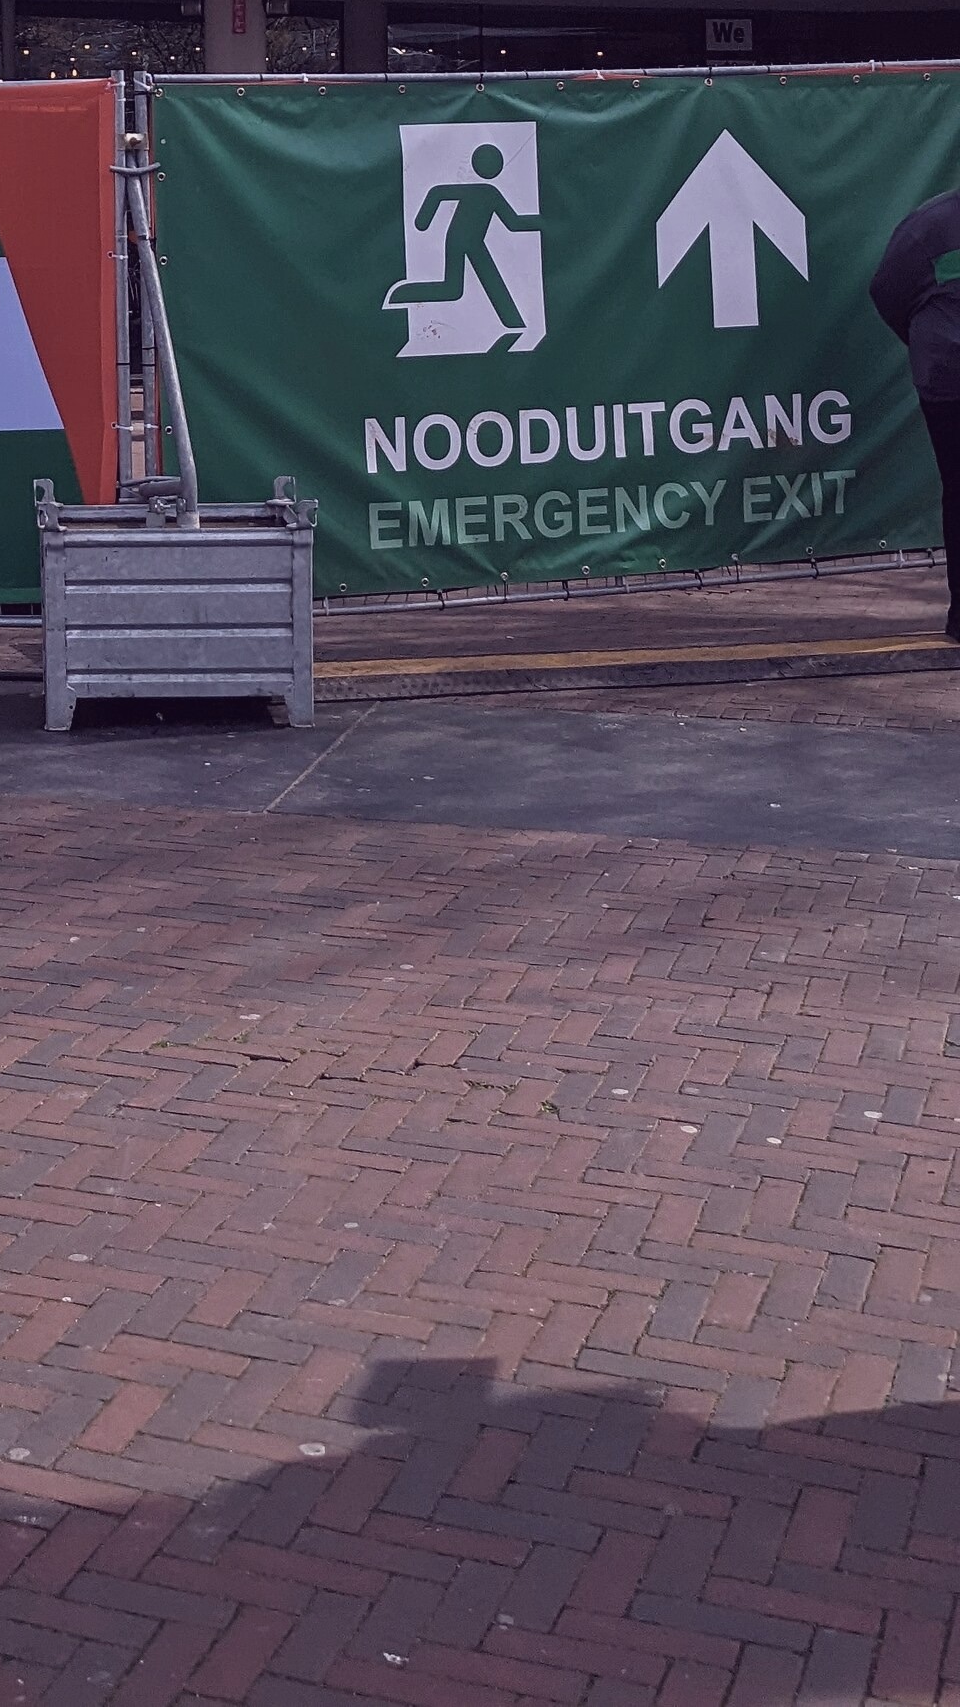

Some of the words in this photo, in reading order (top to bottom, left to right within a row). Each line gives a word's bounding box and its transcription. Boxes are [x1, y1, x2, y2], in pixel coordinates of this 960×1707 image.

[712, 21, 745, 44] We
[364, 390, 852, 474] NOODUITGANG
[368, 479, 727, 551] EMERGENCY
[743, 470, 855, 523] EXIT
